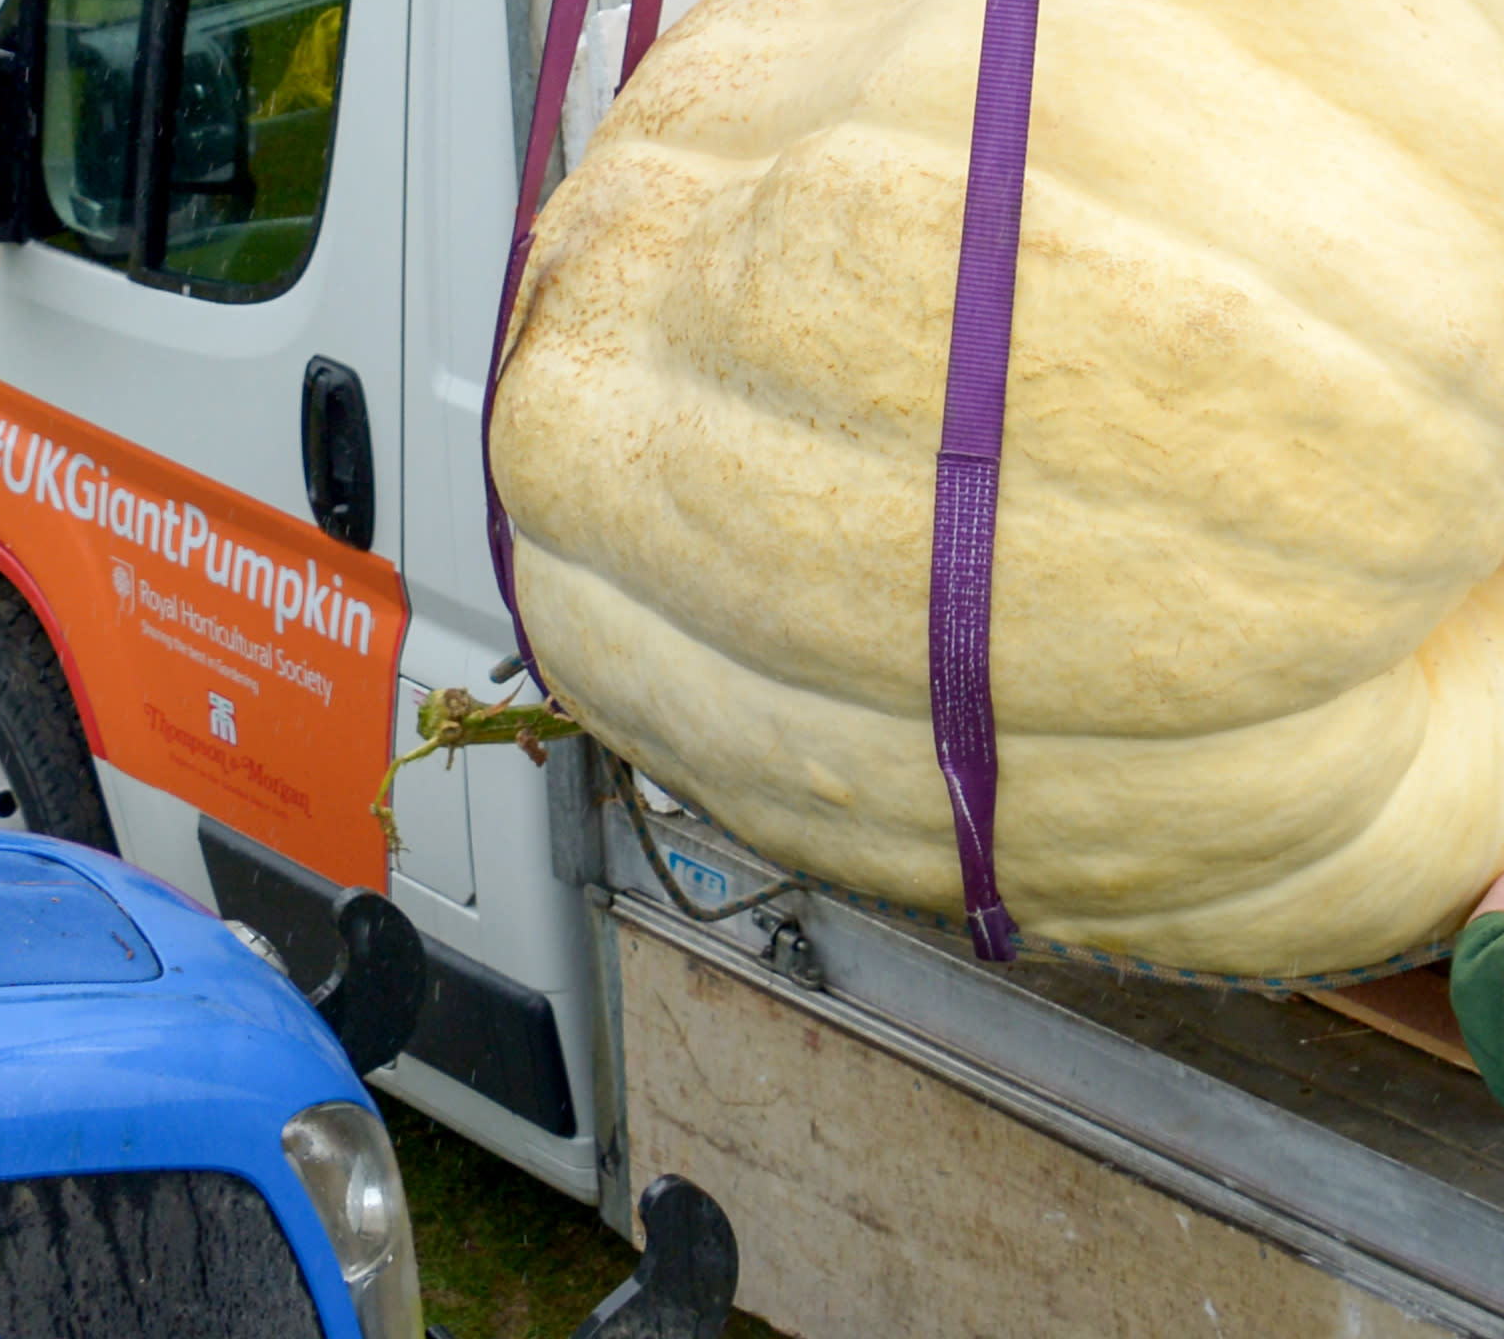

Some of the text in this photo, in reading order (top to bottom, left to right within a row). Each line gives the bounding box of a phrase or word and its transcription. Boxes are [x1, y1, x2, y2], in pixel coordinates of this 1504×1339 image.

[140, 579, 334, 707] Royal Horticultural Society
[144, 701, 230, 774] Thompson
[240, 754, 313, 819] Morgan
